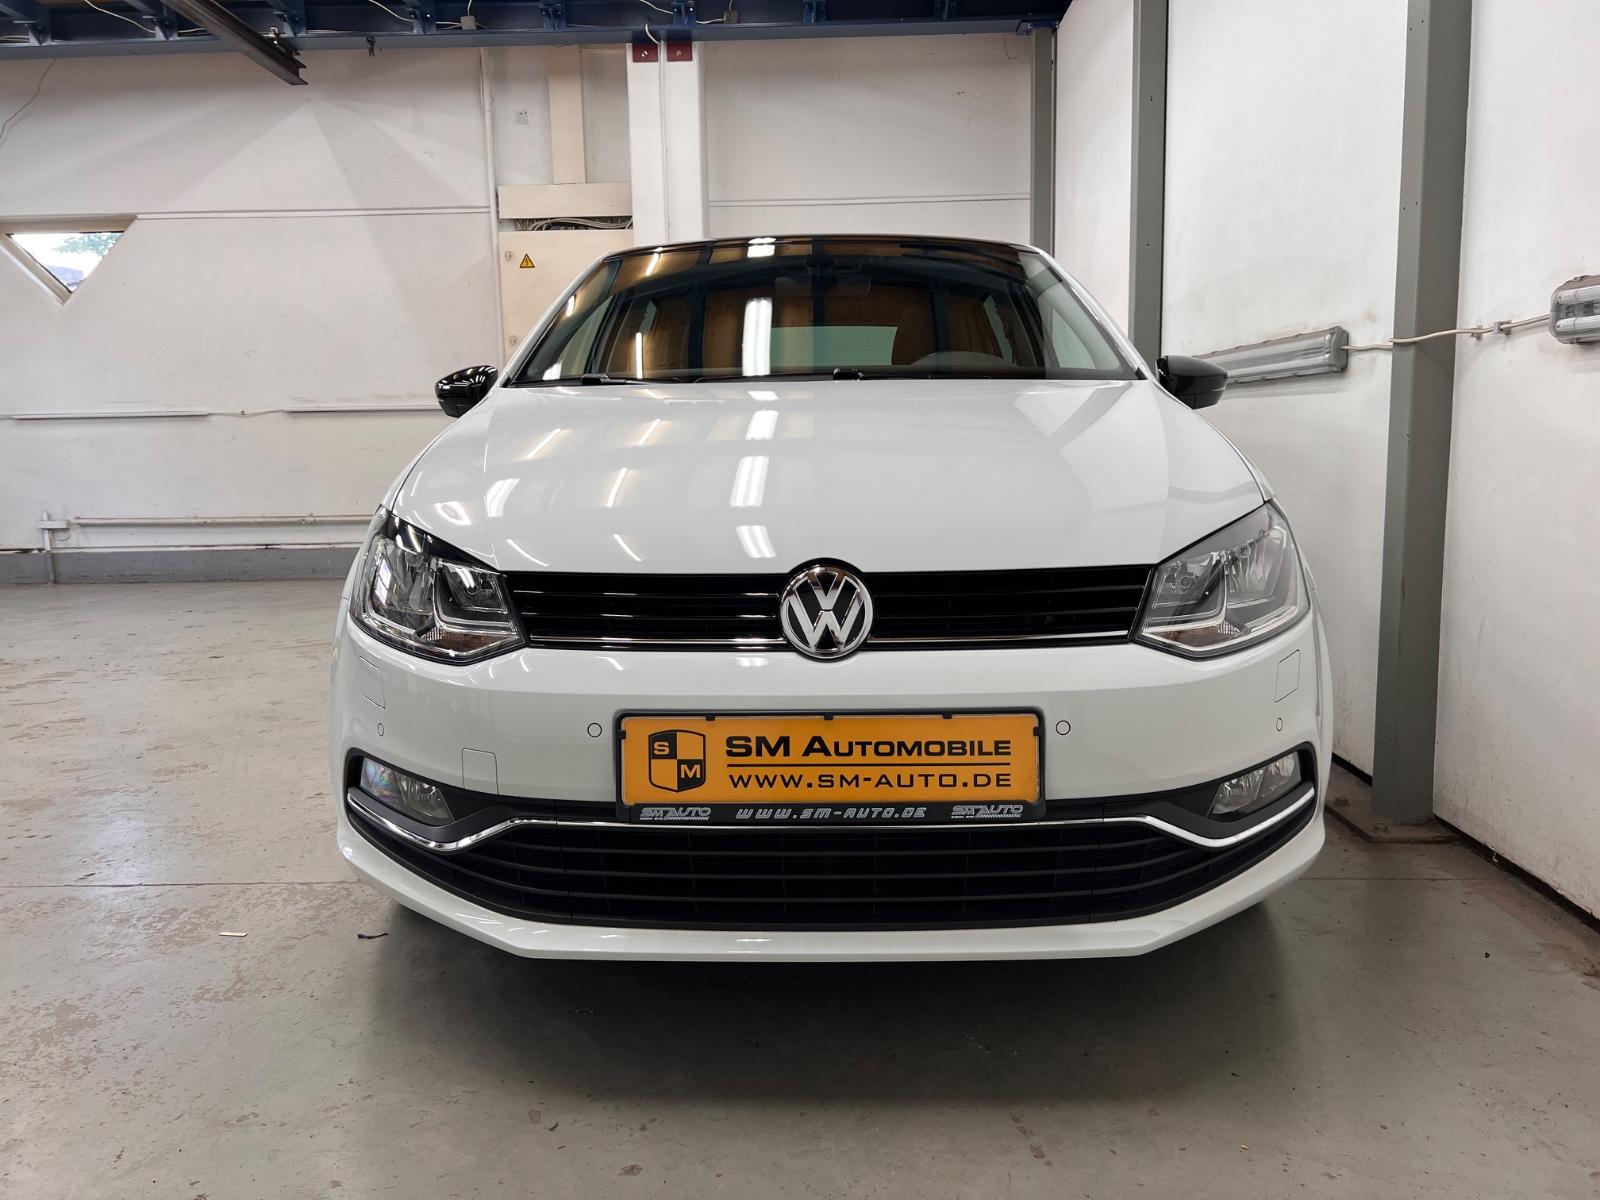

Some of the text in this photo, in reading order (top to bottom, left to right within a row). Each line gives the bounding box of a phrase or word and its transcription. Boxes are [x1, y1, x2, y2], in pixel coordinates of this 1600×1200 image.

[785, 569, 868, 654] VW
[653, 741, 670, 755] S
[725, 736, 790, 757] SM
[680, 764, 700, 778] M
